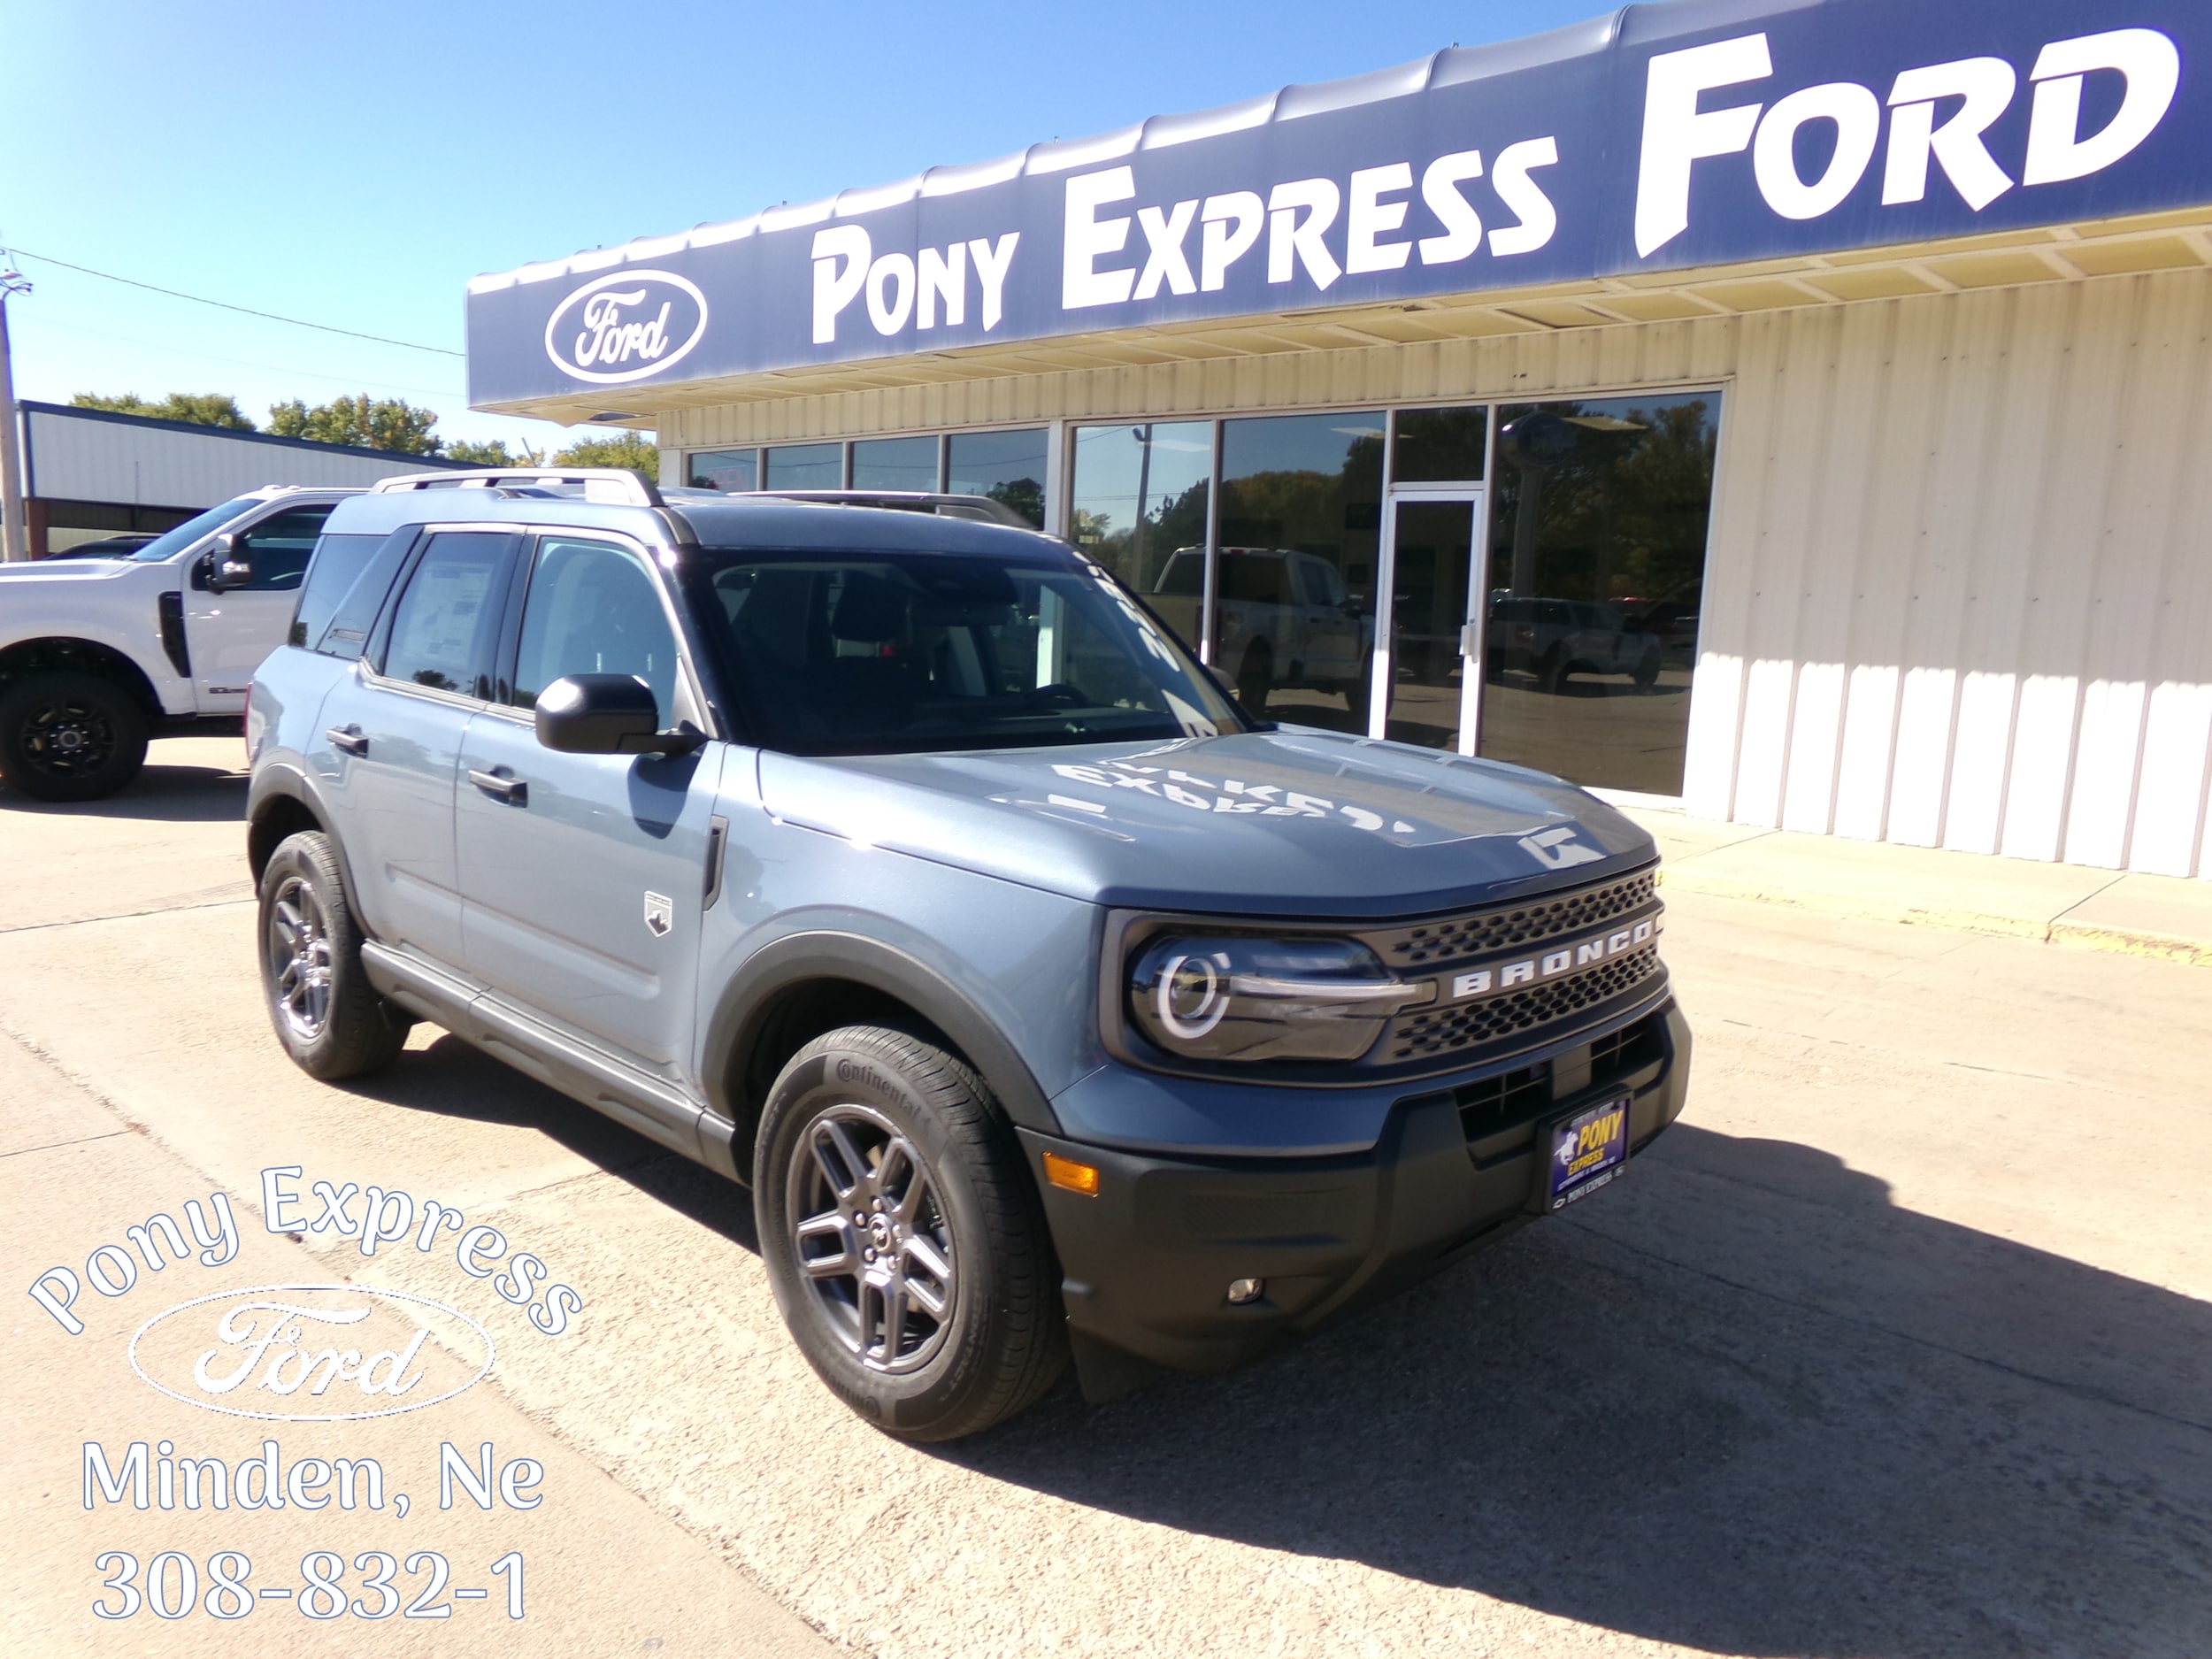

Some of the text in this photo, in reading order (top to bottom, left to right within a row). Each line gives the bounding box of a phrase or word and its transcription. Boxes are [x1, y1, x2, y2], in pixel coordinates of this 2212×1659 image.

[811, 28, 2179, 344] PONY EXPRESS FORD
[575, 288, 670, 367] Ford
[1452, 920, 1652, 998] BRONCO
[836, 1058, 922, 1121] Continental
[1568, 1148, 1605, 1176] EXPRESS
[1577, 1110, 1624, 1156] PONY
